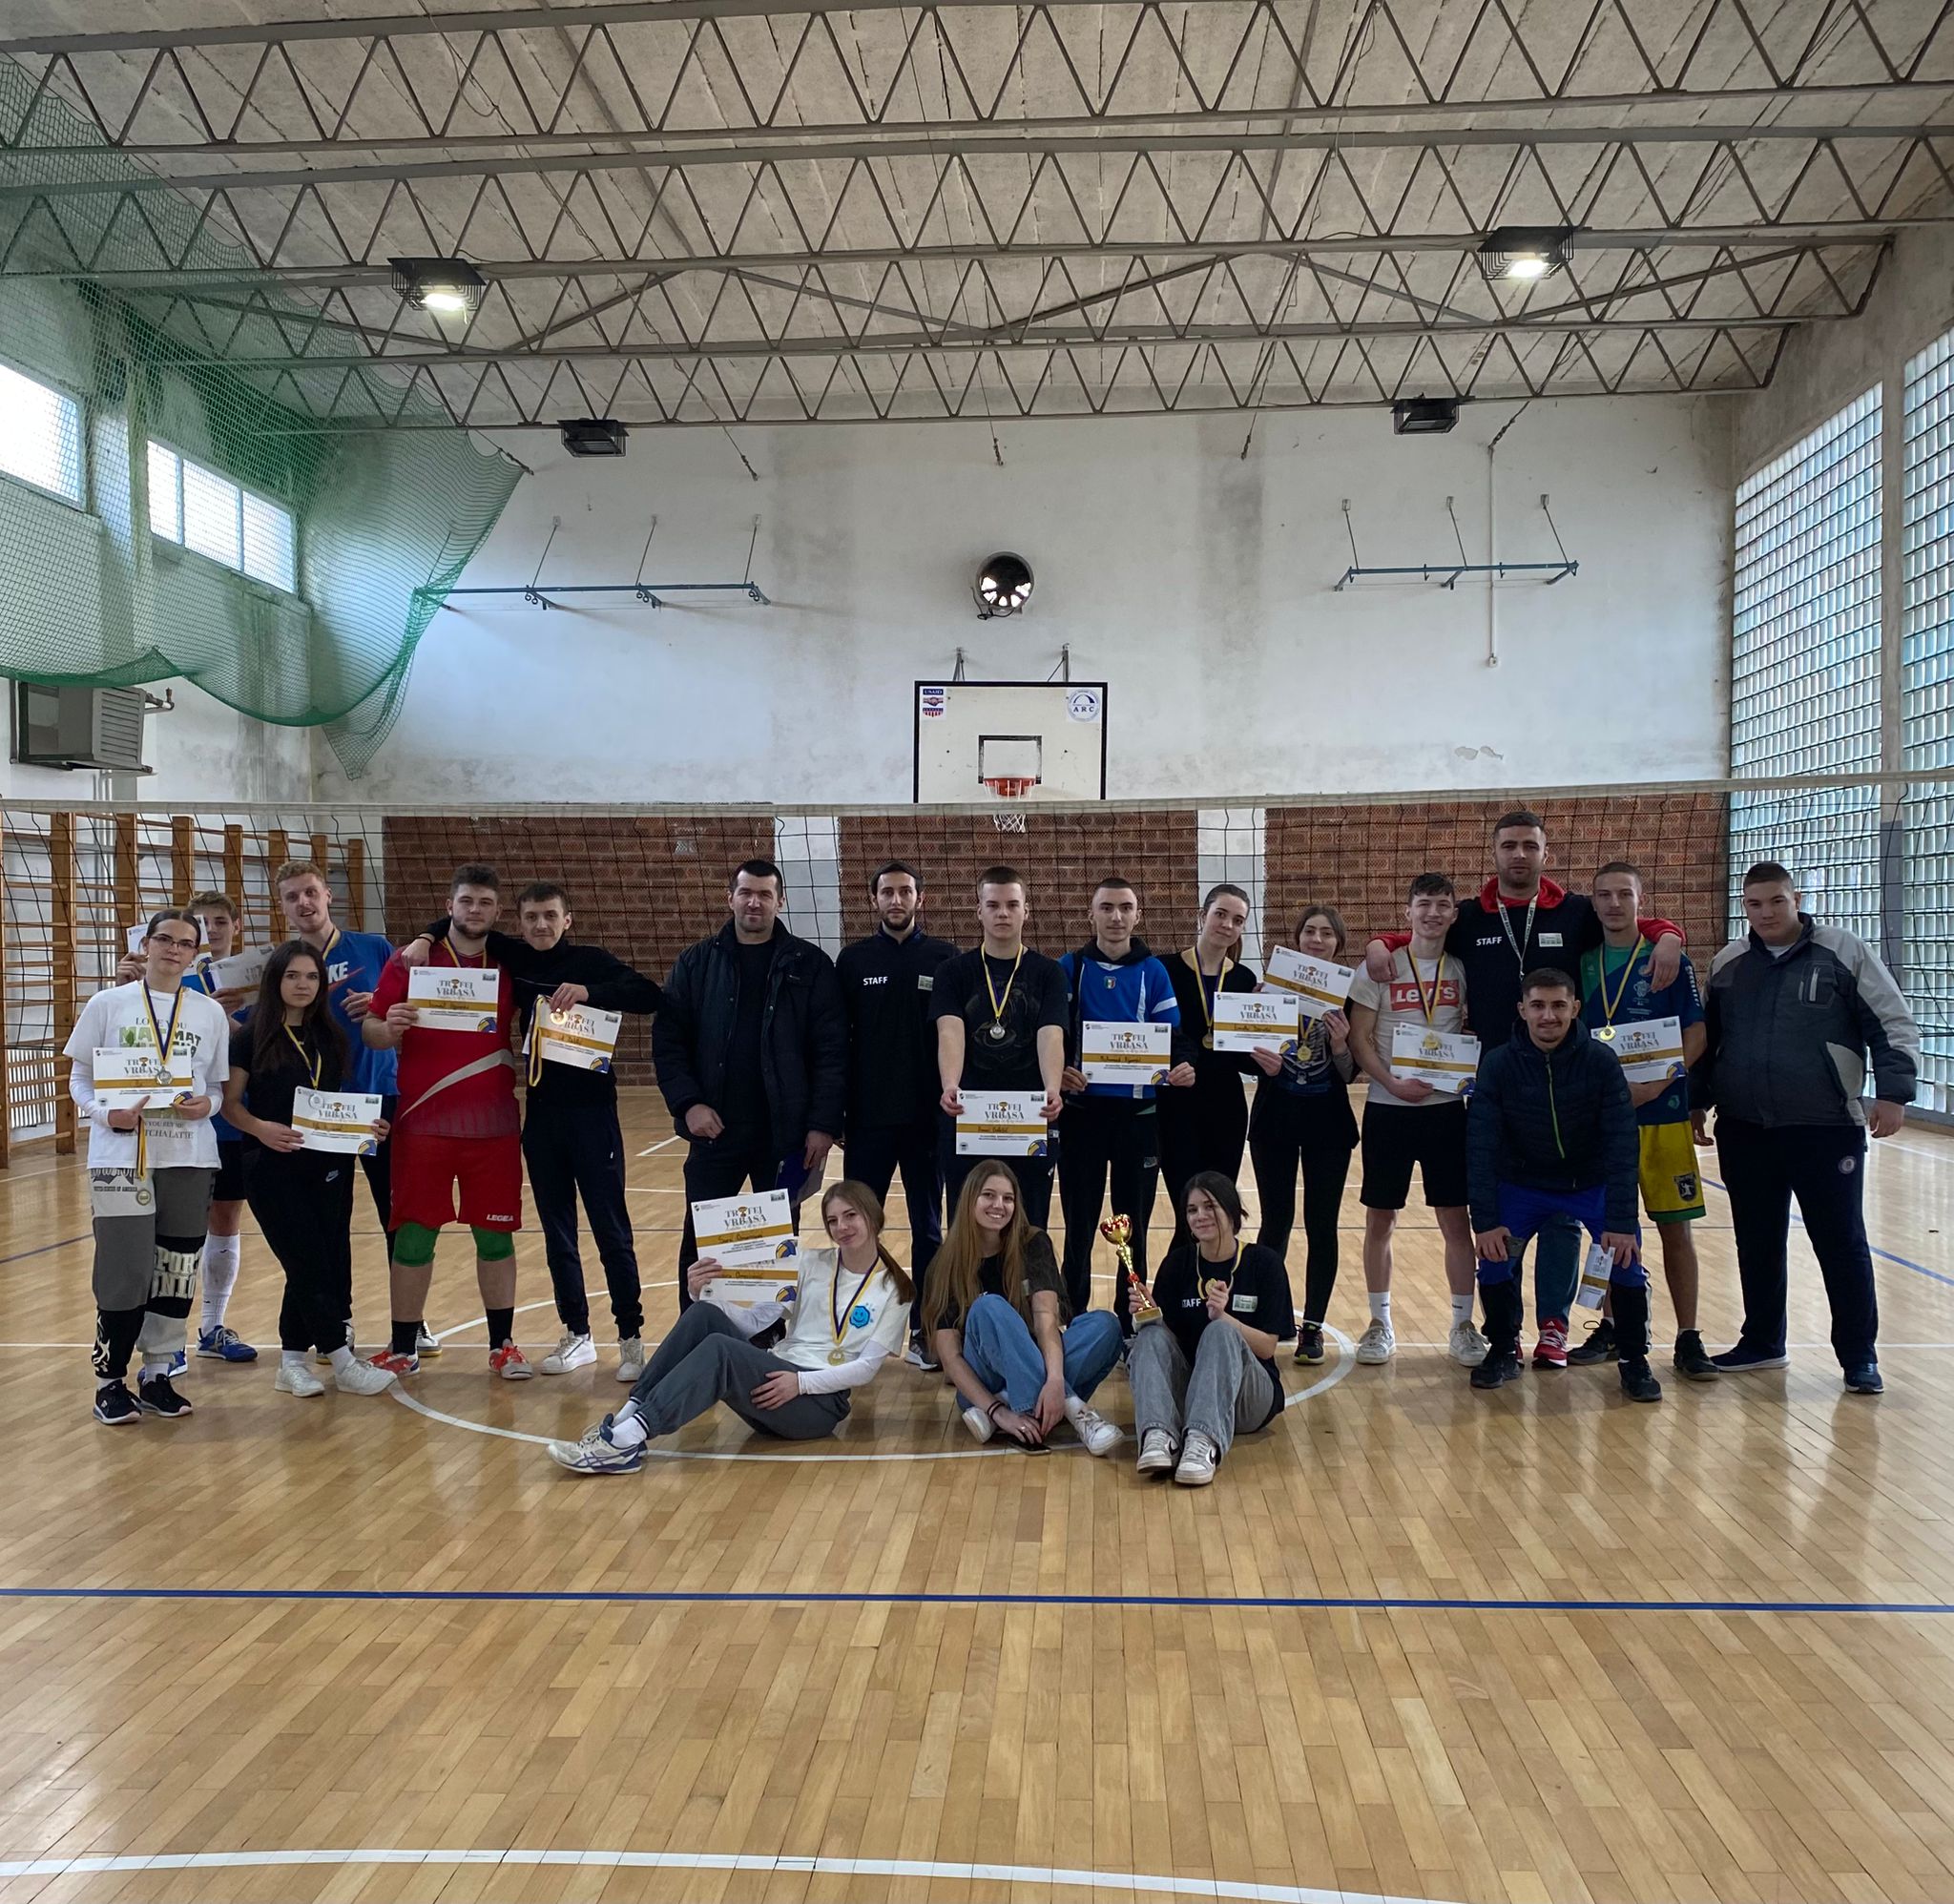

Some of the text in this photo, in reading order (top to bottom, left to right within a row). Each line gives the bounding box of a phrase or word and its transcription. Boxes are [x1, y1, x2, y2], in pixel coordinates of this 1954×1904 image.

[1476, 936, 1503, 946] STAFF
[863, 976, 888, 986] STAFF
[436, 987, 475, 997] VRBASA
[1239, 1011, 1278, 1021] VRBASA
[565, 1021, 595, 1035] RBASA
[1110, 1041, 1149, 1049] VRBASA
[1620, 1039, 1659, 1051] VRBASA
[319, 1109, 358, 1120] VRBASA
[985, 1111, 1025, 1120] VRBASA
[723, 1214, 767, 1228] VRBASA
